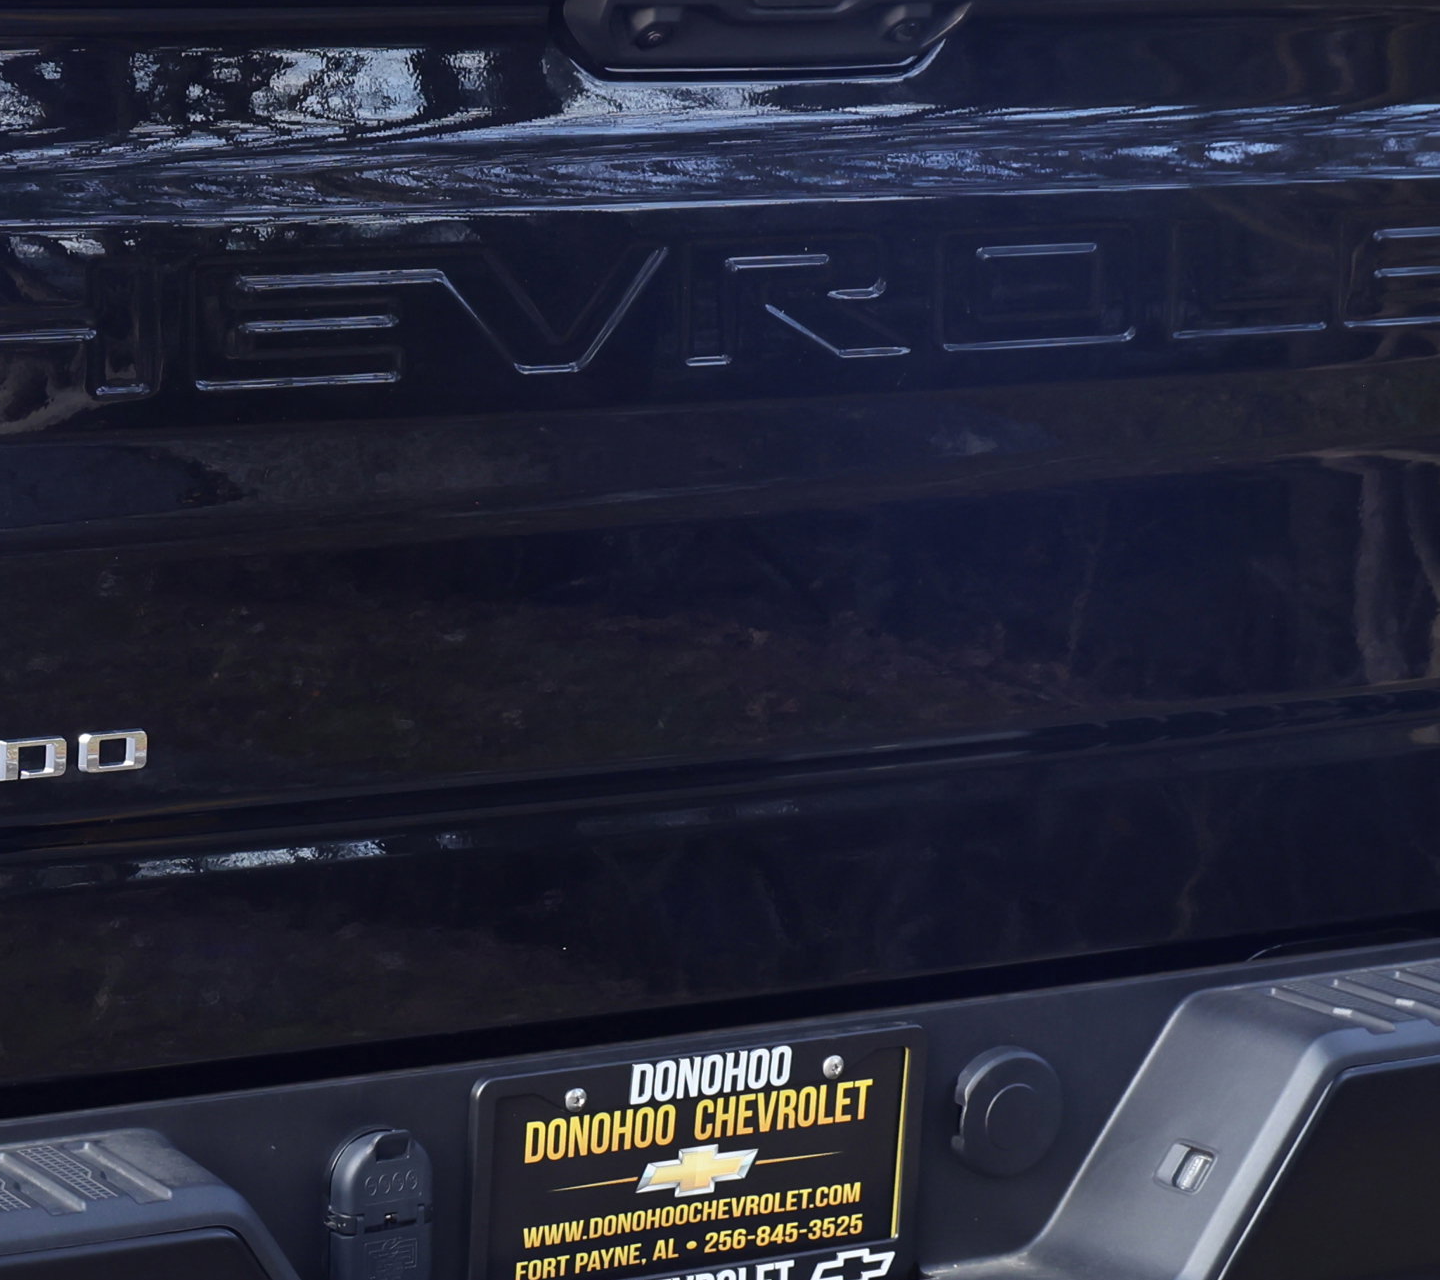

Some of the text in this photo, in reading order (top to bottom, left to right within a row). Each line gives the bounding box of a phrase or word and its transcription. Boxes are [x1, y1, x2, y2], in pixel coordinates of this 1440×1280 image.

[629, 1045, 793, 1106] DONOHOO
[523, 1078, 873, 1165] DONOHOO CHEVROLET
[522, 1181, 862, 1250] WWW.DONOHOOCHEVROLET.COM
[574, 1243, 648, 1274] PAYNE,
[652, 1238, 680, 1262] AL
[703, 1213, 864, 1255] 256-845-3525
